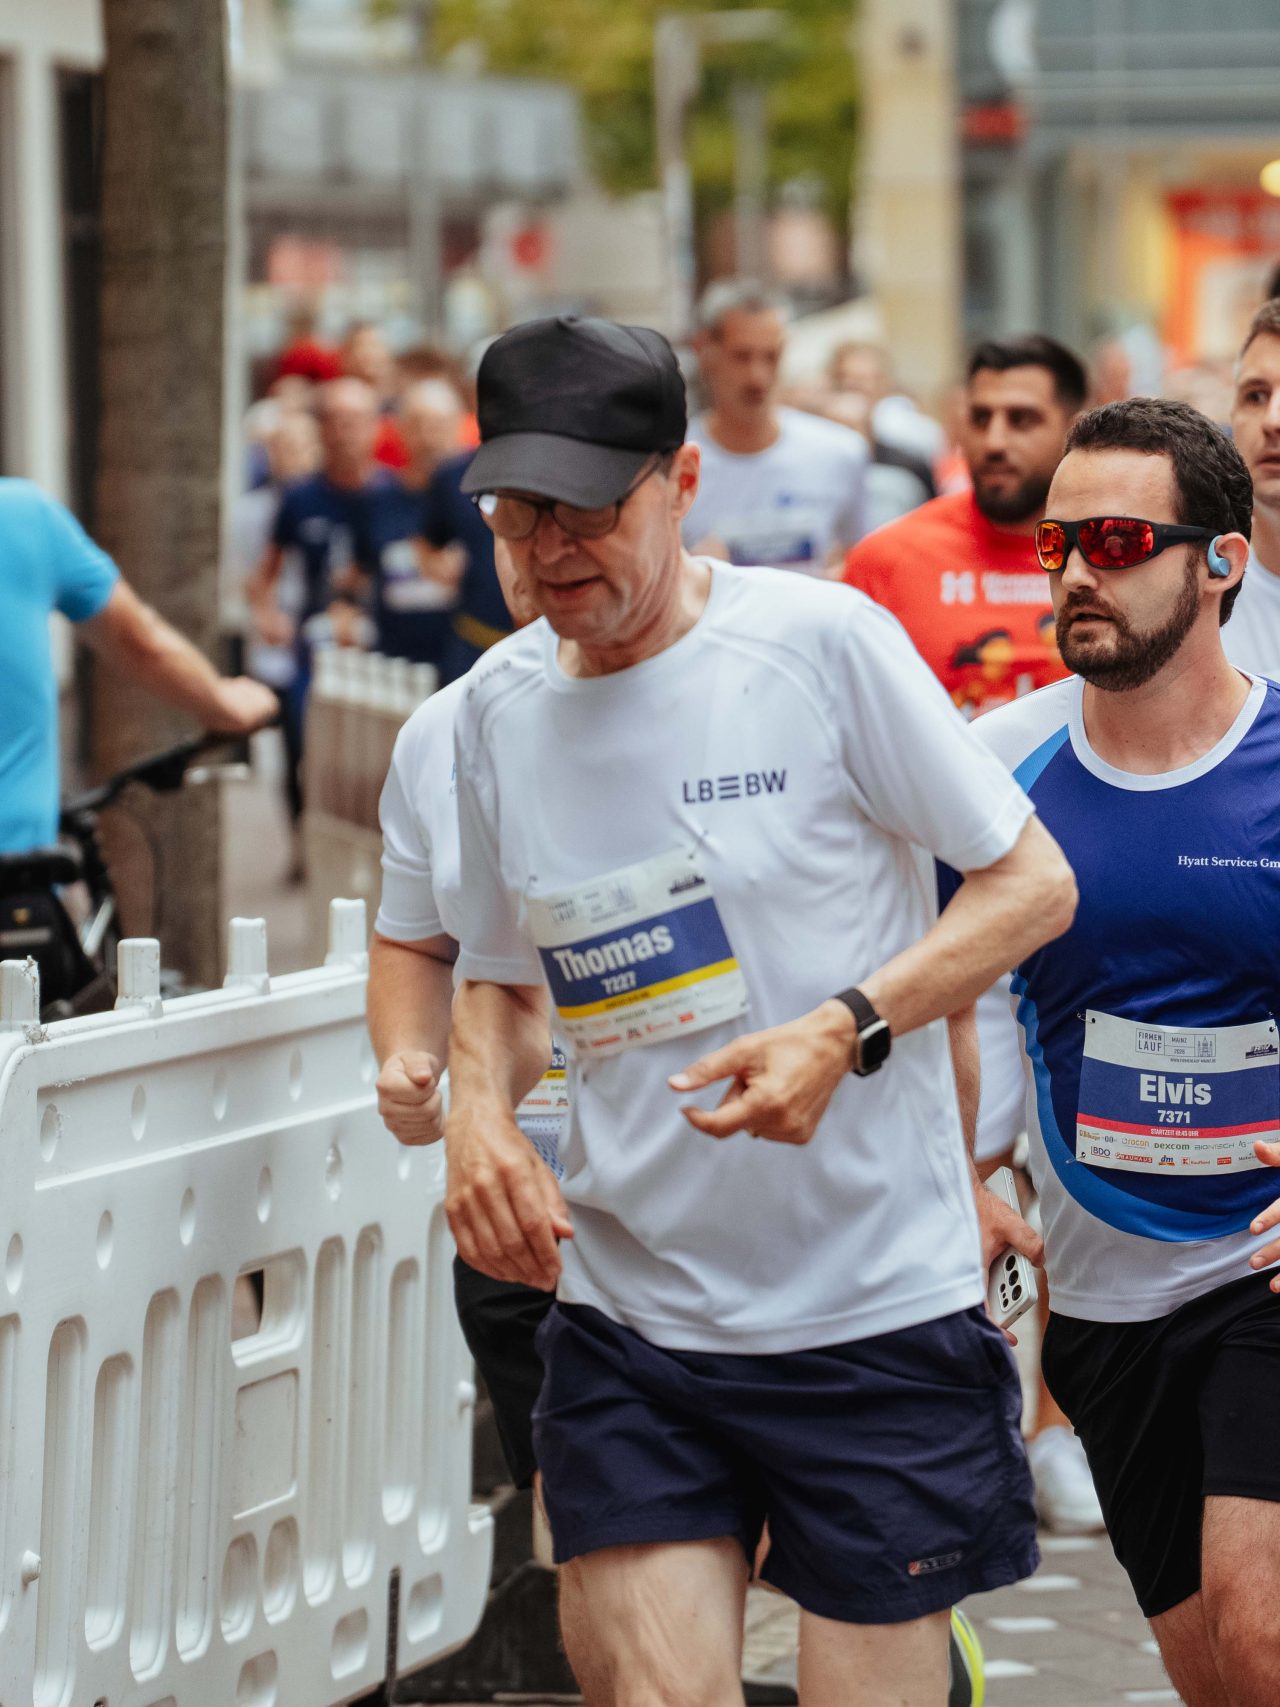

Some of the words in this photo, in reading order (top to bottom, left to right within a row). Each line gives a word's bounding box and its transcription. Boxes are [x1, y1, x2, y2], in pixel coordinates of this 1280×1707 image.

[1178, 855, 1209, 868] Hyatt
[1211, 856, 1258, 868] Services
[552, 925, 675, 983] Thomas
[1138, 1031, 1162, 1041] FIRMEN
[1138, 1040, 1162, 1052] LAUF
[1139, 1073, 1212, 1106] Elvis
[1157, 1109, 1191, 1124] 7371
[1093, 1146, 1111, 1157] BDO
[1121, 1153, 1152, 1164] BAUHAUS
[1160, 1154, 1174, 1163] dm
